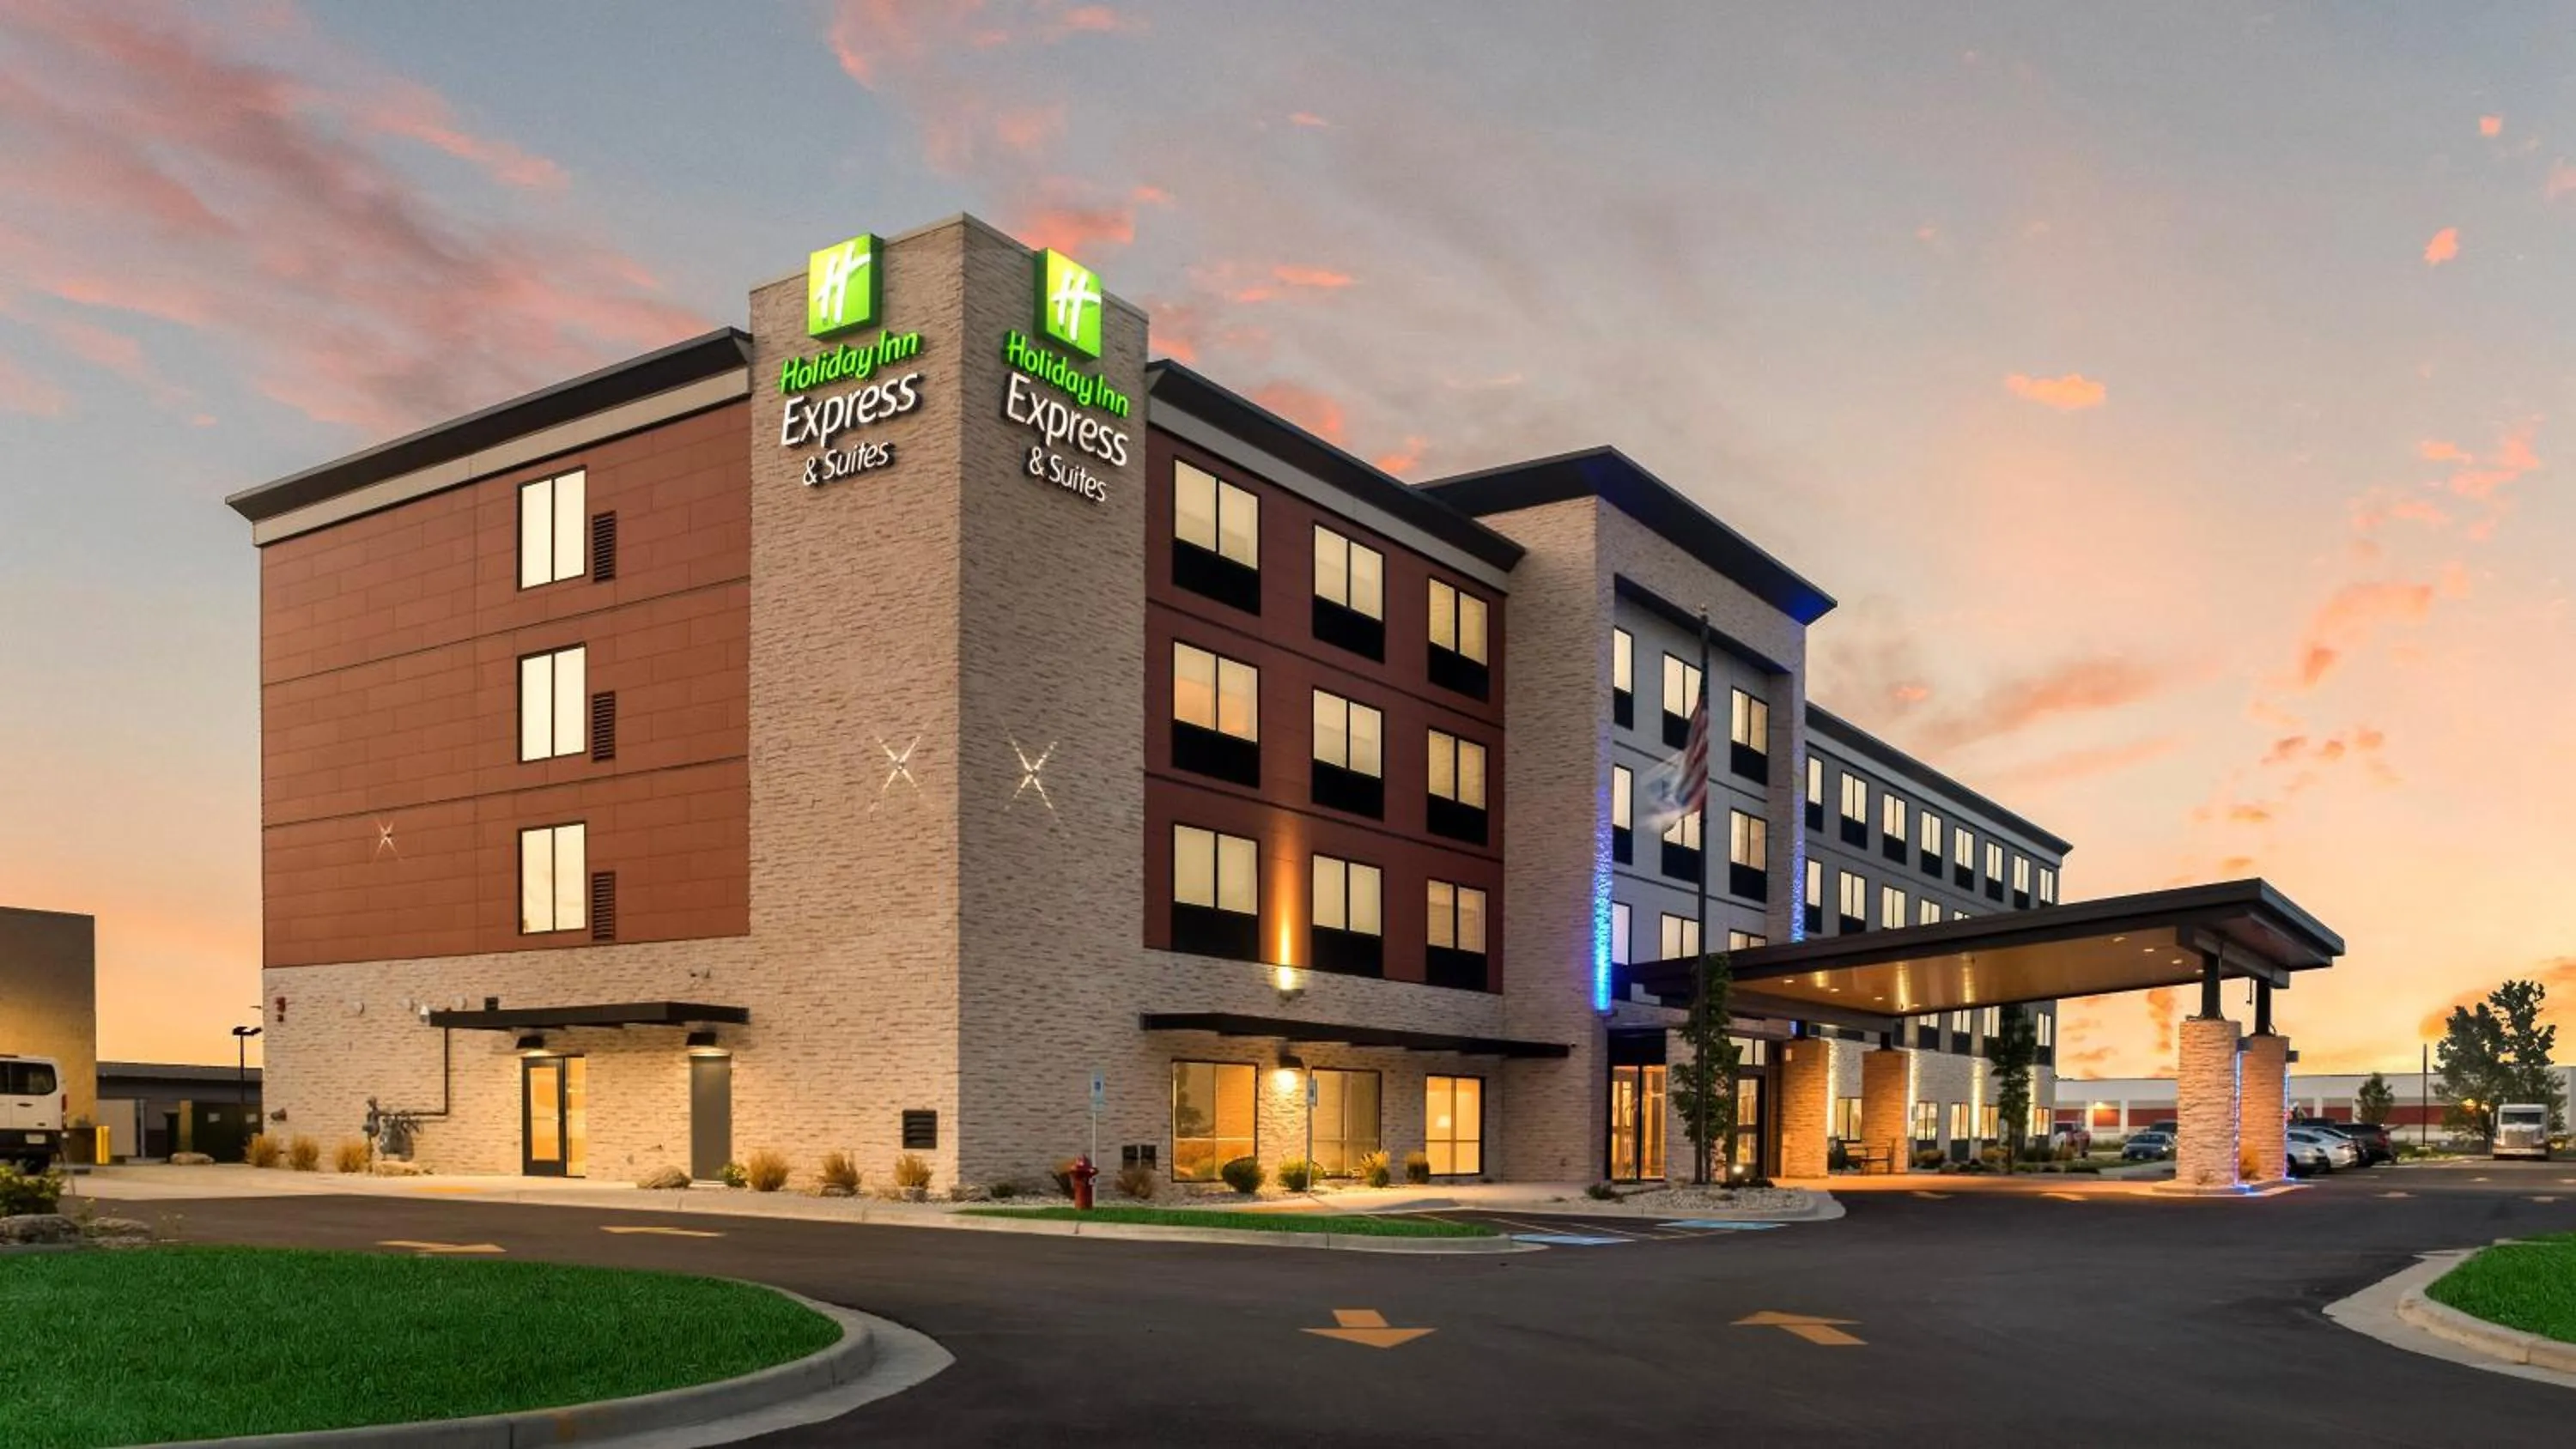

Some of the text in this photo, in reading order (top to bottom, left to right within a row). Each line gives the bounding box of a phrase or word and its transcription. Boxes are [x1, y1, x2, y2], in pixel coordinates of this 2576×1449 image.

[781, 330, 920, 394] Holiday Inn
[1006, 329, 1129, 418] Holiday Inn
[781, 373, 918, 448] Express
[1006, 371, 1129, 467] Express
[803, 441, 890, 486] & Suites
[1030, 446, 1107, 503] & Suites
